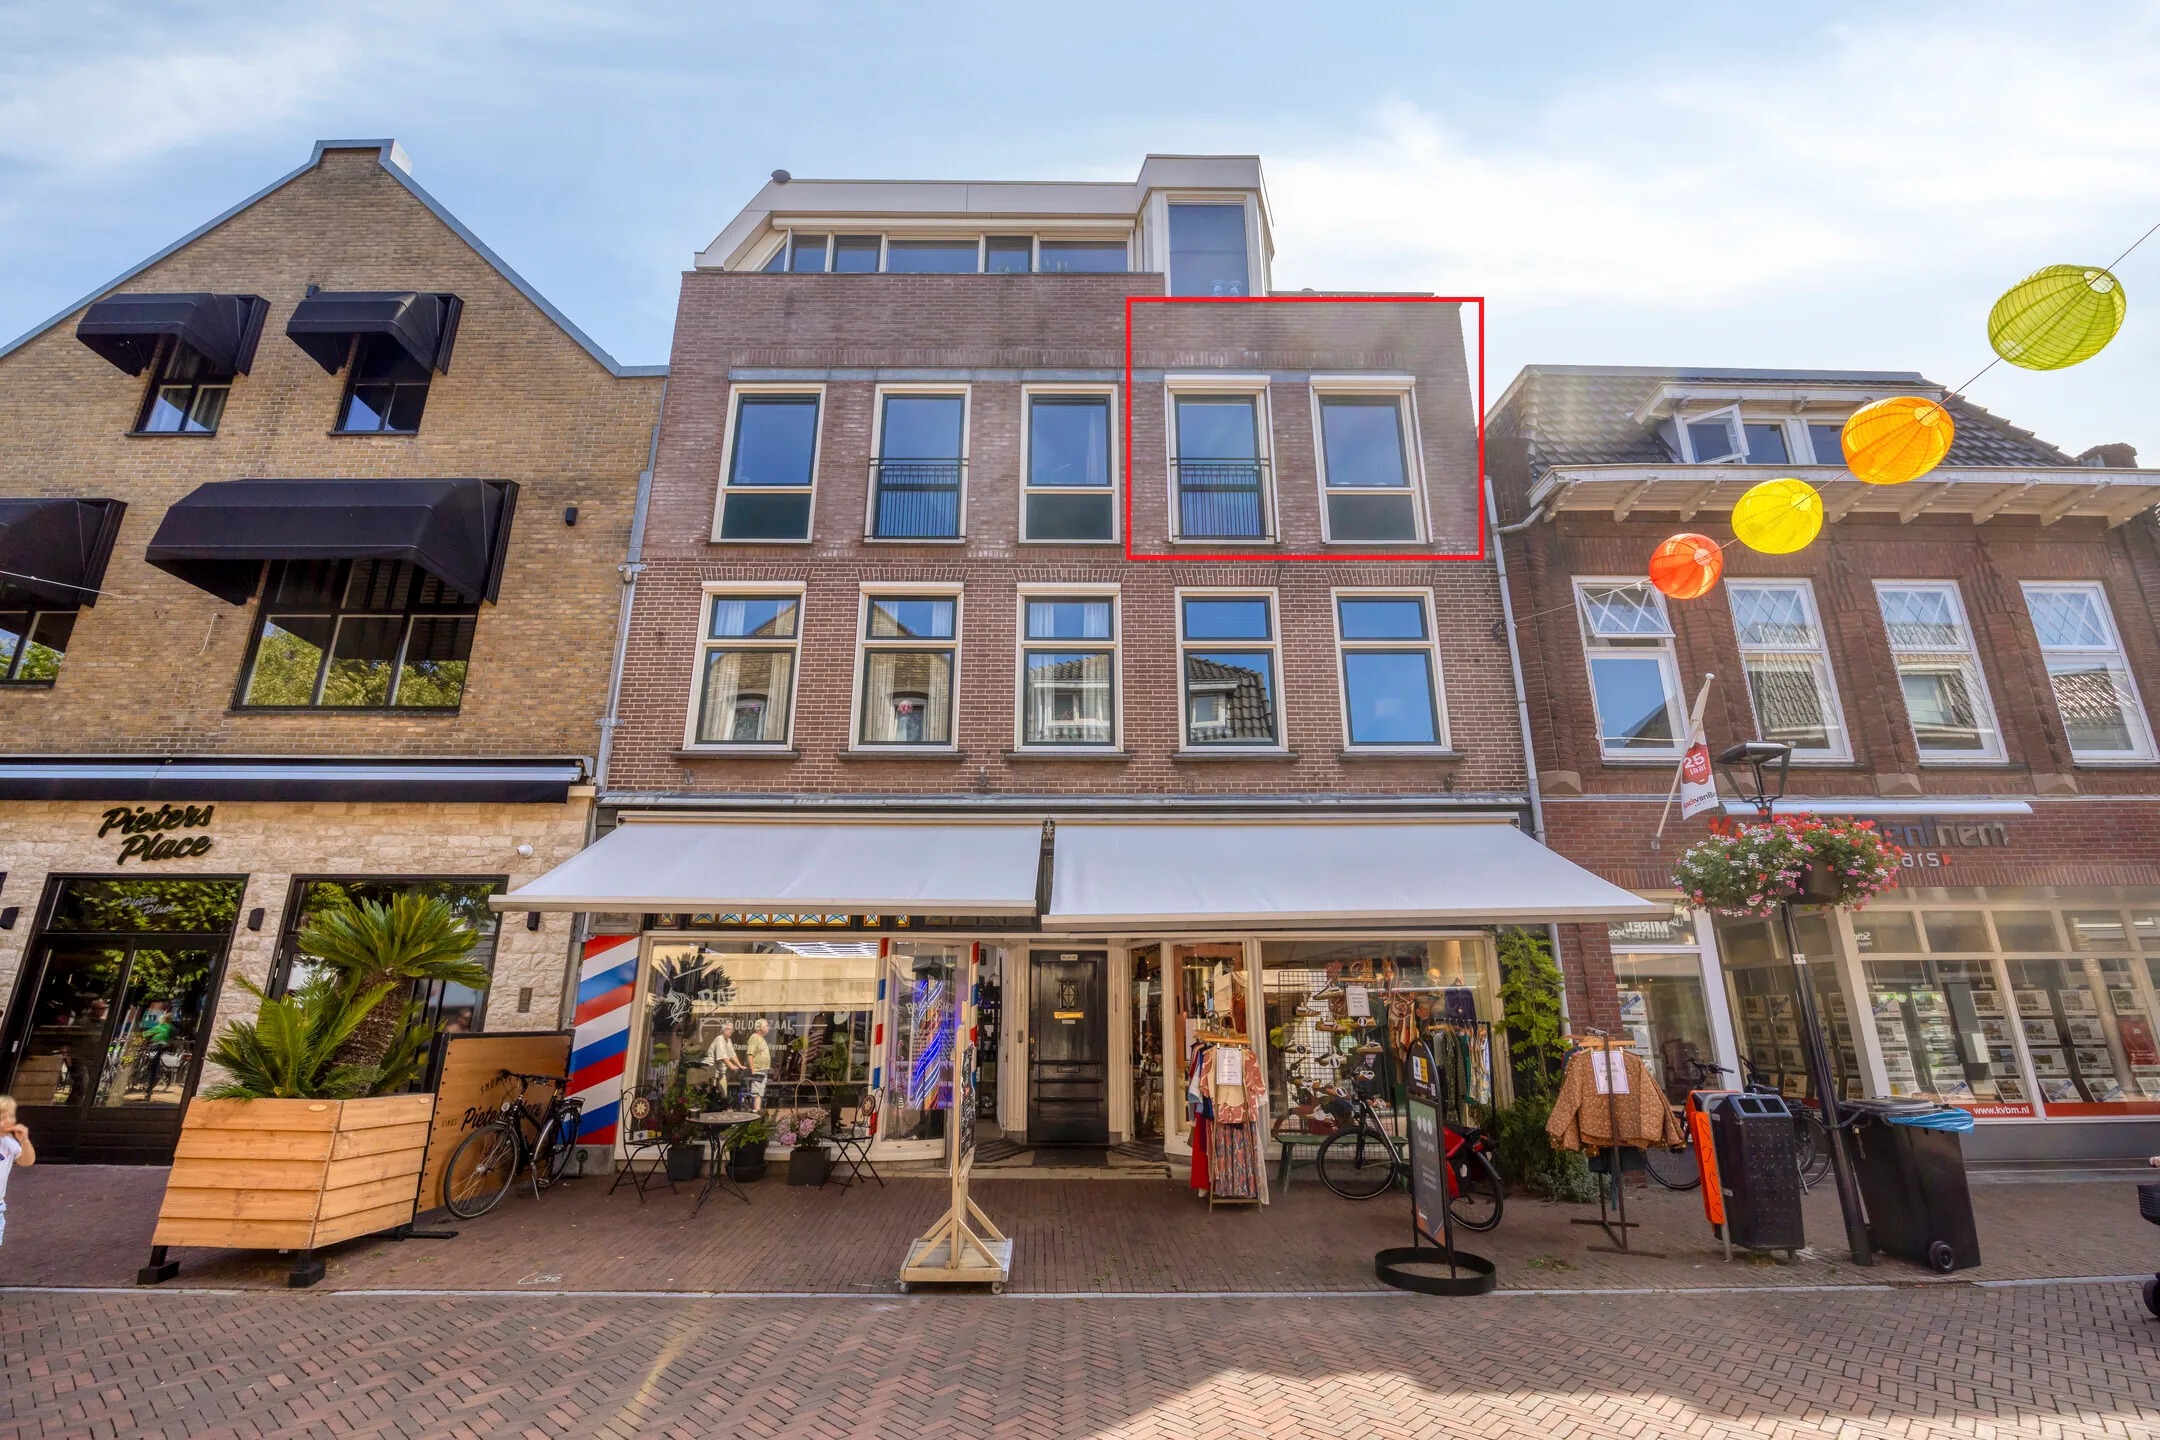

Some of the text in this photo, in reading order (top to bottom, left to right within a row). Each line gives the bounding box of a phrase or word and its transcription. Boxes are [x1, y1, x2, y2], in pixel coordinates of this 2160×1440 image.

[1683, 752, 1705, 769] 25
[98, 803, 215, 838] Pieters
[117, 832, 212, 865] Place
[735, 1019, 793, 1030] OLDEZAAL
[1973, 1105, 2030, 1115] www.kvbm.nl
